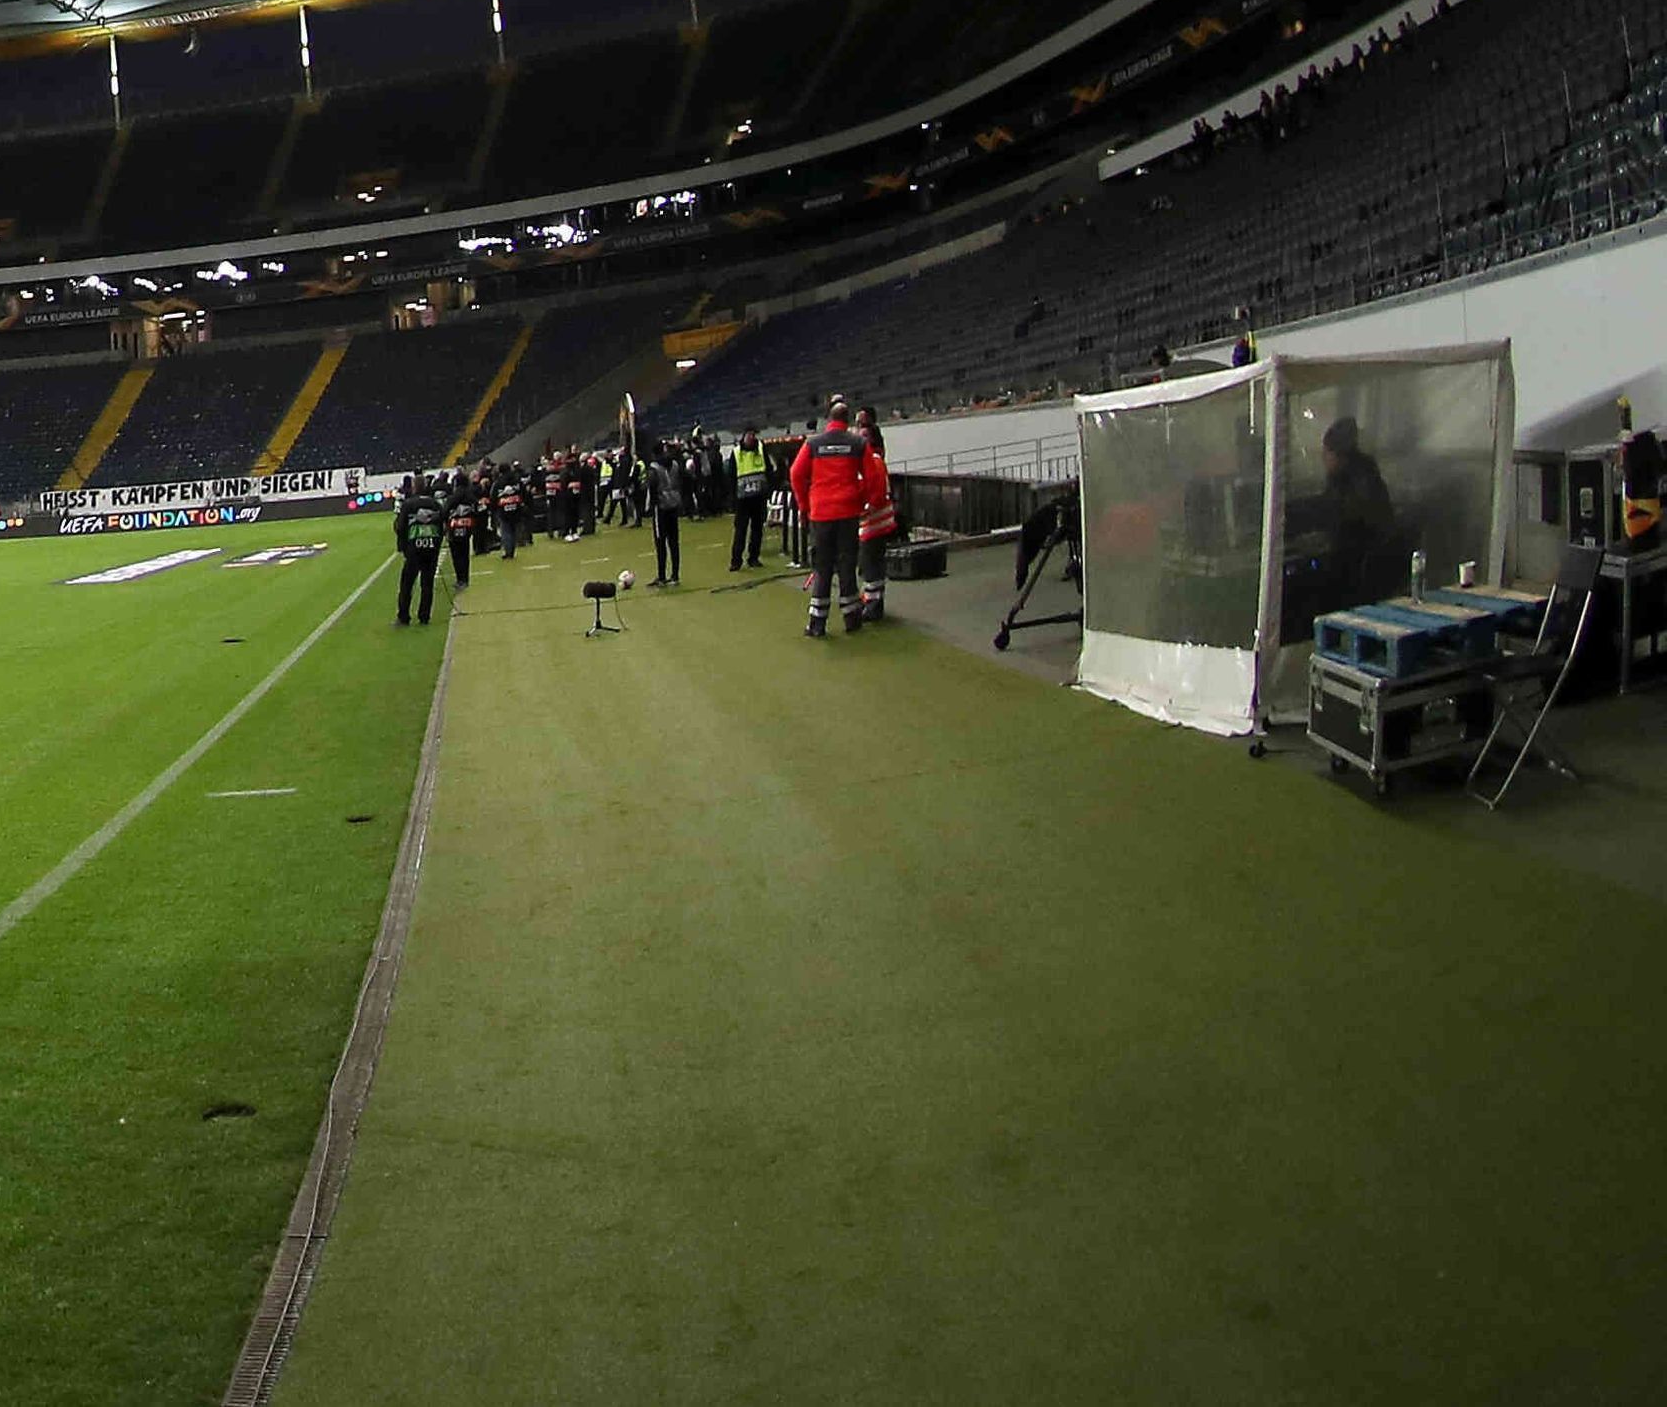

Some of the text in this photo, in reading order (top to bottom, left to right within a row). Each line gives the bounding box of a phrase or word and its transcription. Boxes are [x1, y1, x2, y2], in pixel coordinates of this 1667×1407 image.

[215, 479, 250, 496] UND
[260, 470, 333, 493] SIEGEN!
[60, 516, 103, 534] UEFA
[415, 538, 435, 548] 001
